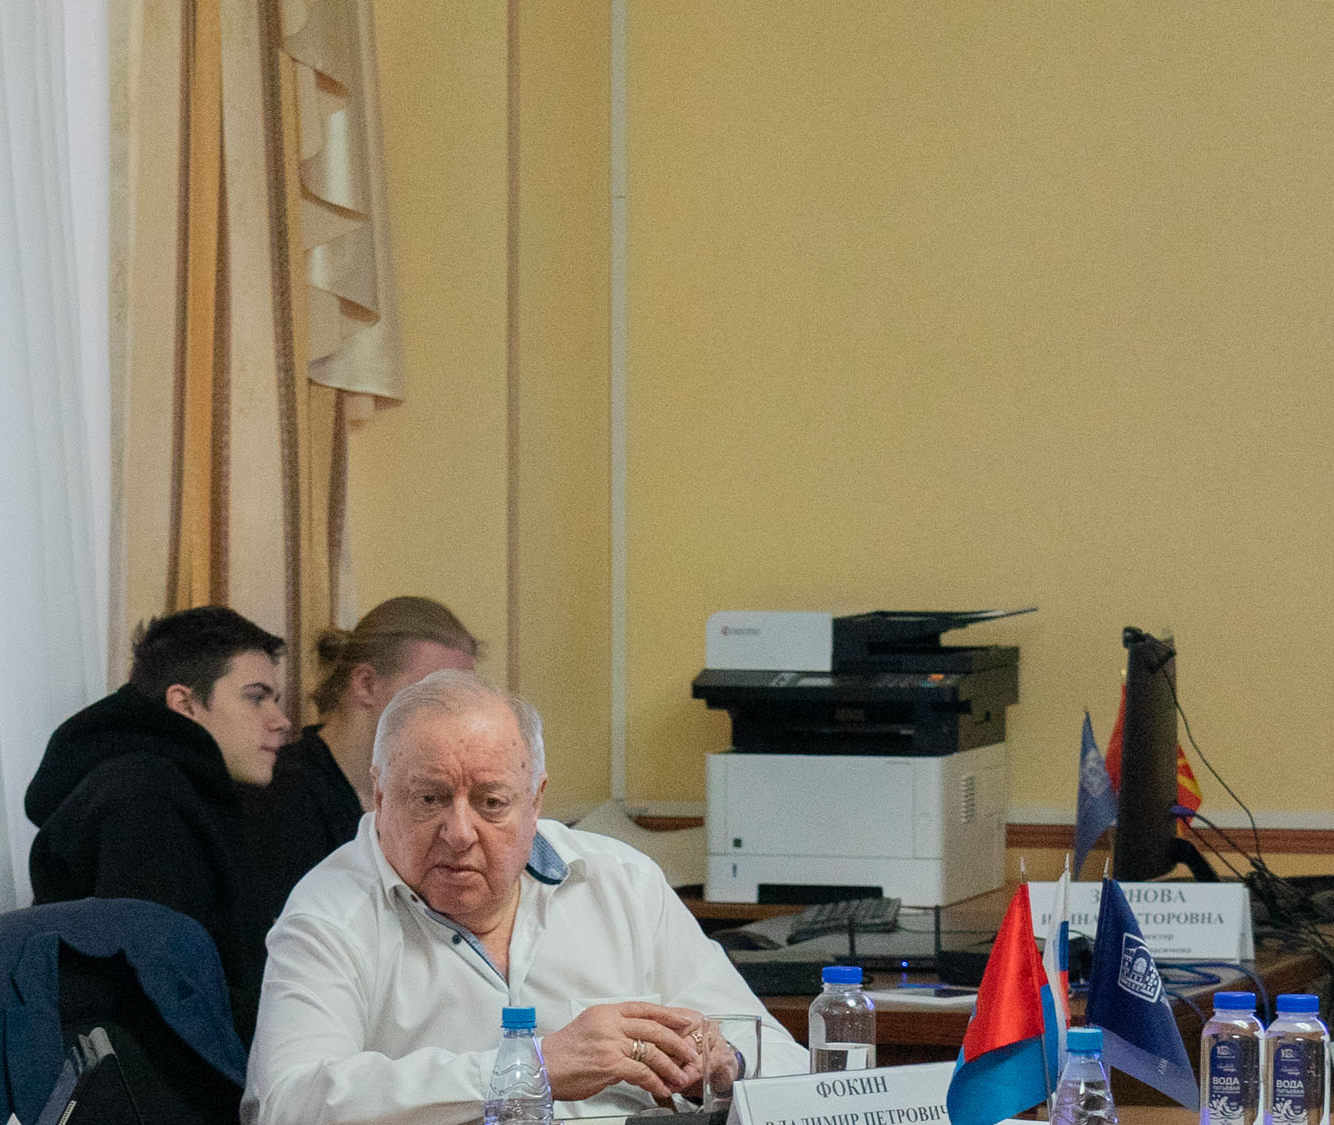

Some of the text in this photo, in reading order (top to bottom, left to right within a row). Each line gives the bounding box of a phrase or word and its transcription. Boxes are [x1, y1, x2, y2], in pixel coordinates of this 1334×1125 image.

[1091, 888, 1187, 904] ЗНОВА
[816, 1075, 889, 1099] ФОКИН
[1212, 1076, 1240, 1086] ВОДА
[1276, 1079, 1304, 1089] ВОДА
